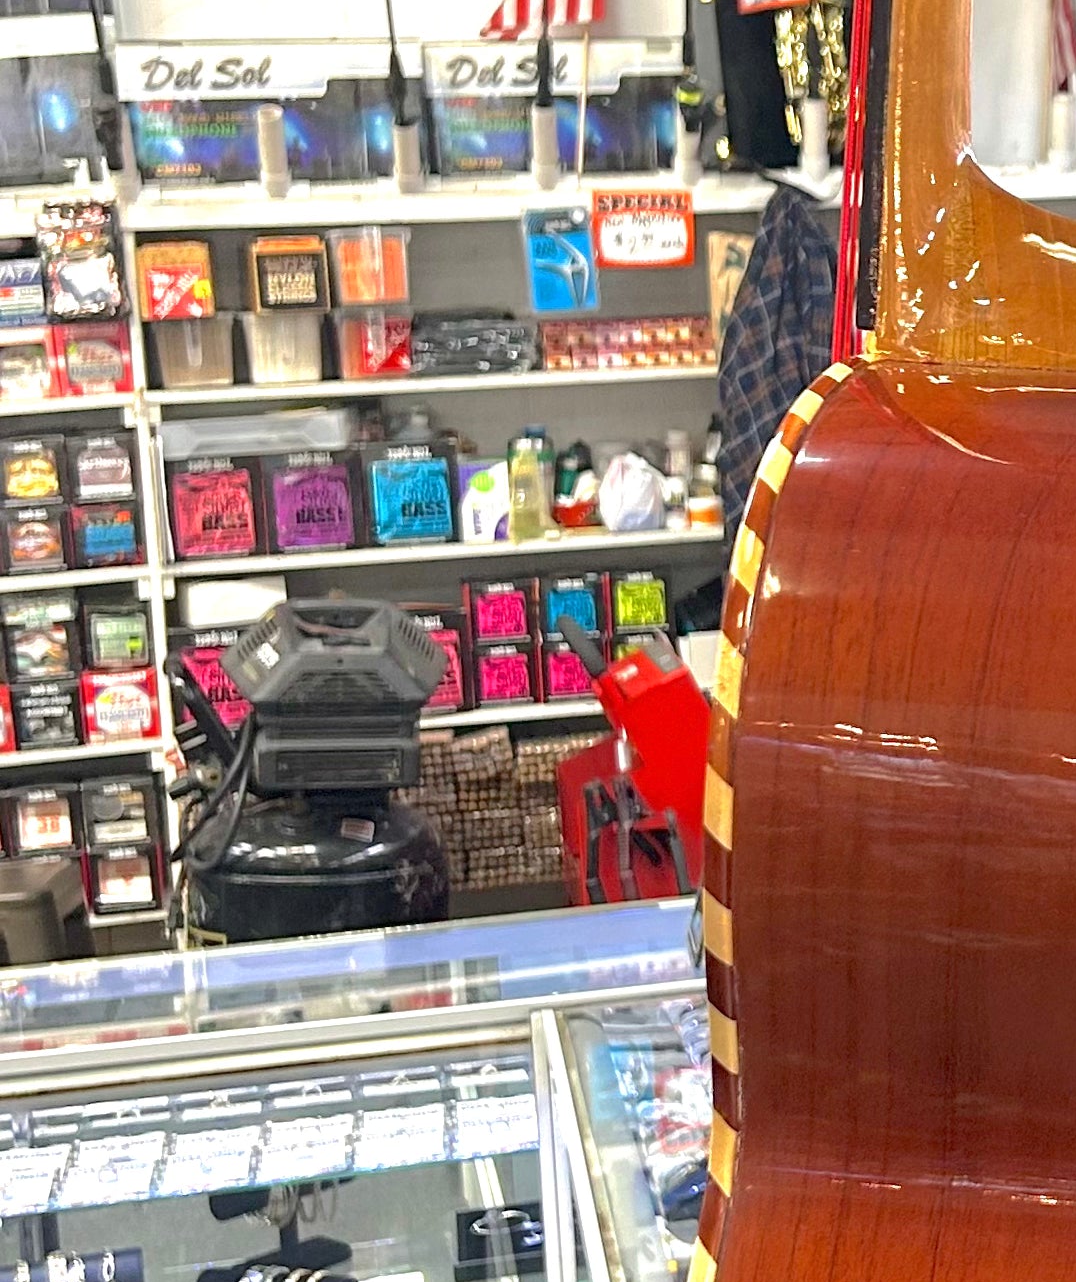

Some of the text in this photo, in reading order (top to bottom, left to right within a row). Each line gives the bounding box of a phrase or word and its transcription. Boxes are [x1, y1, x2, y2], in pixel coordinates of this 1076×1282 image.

[140, 55, 273, 91] Del Sol
[446, 53, 569, 88] Del Sl
[598, 194, 688, 212] SPECIAL
[402, 500, 448, 518] BASS
[202, 513, 249, 531] BASS
